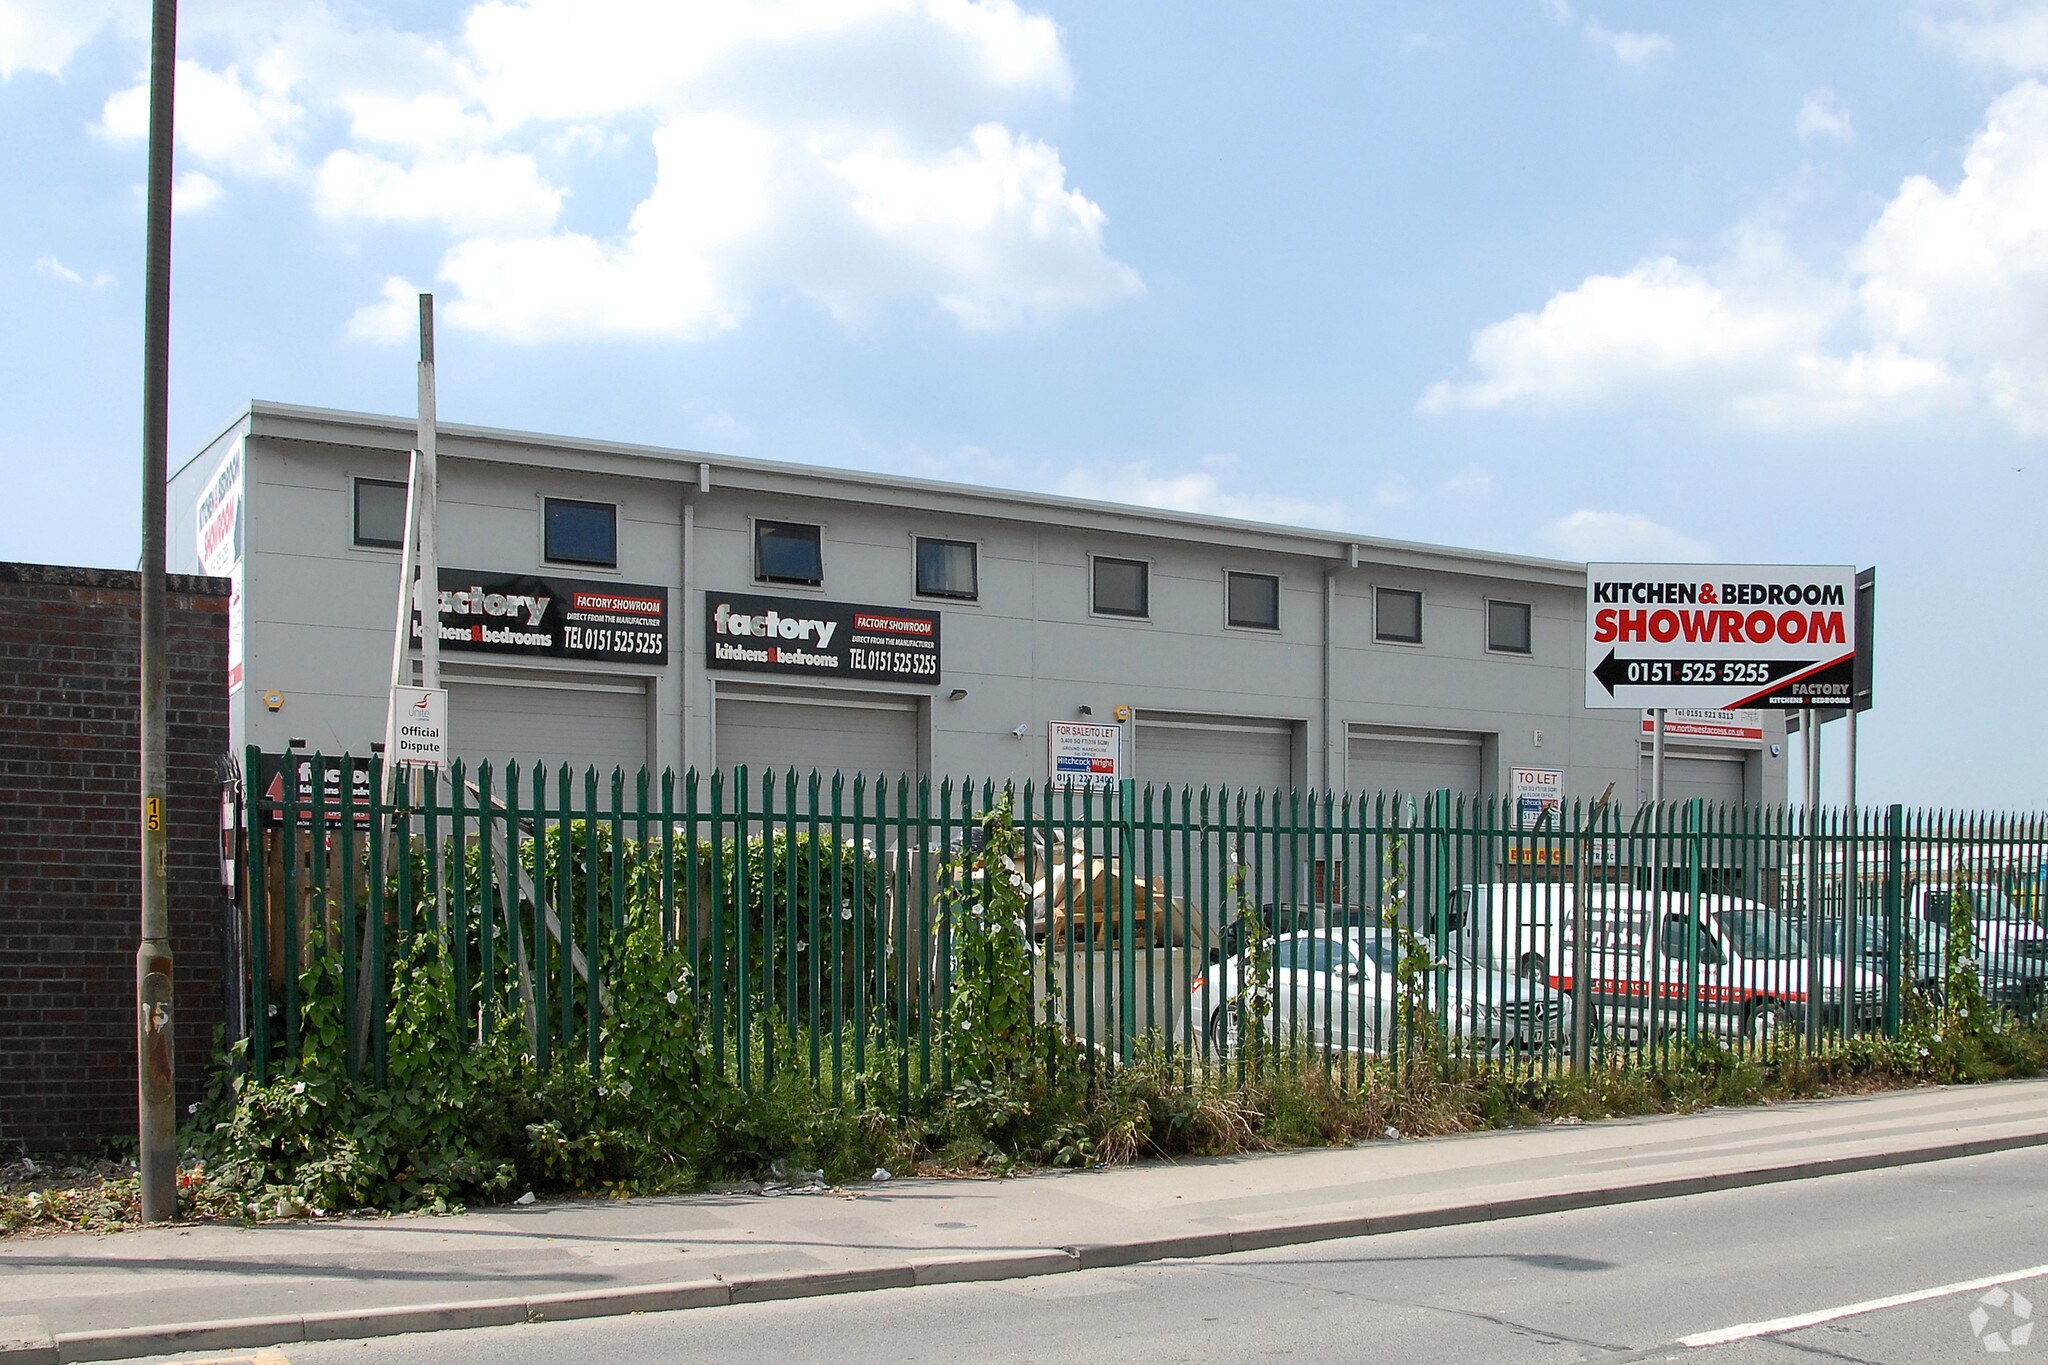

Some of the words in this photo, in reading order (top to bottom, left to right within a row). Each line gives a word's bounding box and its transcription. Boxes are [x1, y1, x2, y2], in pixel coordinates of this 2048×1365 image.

[577, 596, 612, 609] FACTORY
[612, 599, 660, 612] SHOWROOM
[566, 612, 587, 621] DIRECT
[587, 613, 604, 622] FROM
[605, 615, 616, 623] THE
[616, 616, 660, 627] MANUFACTURER
[857, 617, 888, 629] FACTORY
[888, 620, 931, 633] SHOWROOM
[1593, 608, 1847, 644] SHOWROOM
[714, 604, 837, 649] factory
[564, 626, 583, 649] TEL
[585, 628, 611, 651] 0151
[613, 630, 634, 653] 525
[635, 632, 662, 655] 5255
[852, 635, 870, 644] DIRECT
[870, 636, 885, 645] FROM
[885, 637, 895, 646] THE
[895, 638, 935, 649] MANUFACTURER
[850, 648, 866, 669] TEL
[868, 650, 892, 671] 0151
[893, 652, 912, 673] 525
[912, 653, 937, 675] 5255
[1792, 683, 1849, 695] FACTORY
[1769, 696, 1803, 704] KITCHENS
[1675, 708, 1685, 716] Tel
[1686, 709, 1702, 717] 0151
[401, 726, 439, 738] Official
[1056, 725, 1071, 735] FOR
[1101, 729, 1114, 738] LET
[400, 740, 440, 753] Dispute
[1057, 757, 1091, 765] Hitchcock
[1092, 758, 1113, 768] Wright
[1079, 774, 1093, 782] 227
[1518, 772, 1534, 783] TO
[1537, 773, 1557, 784] LET
